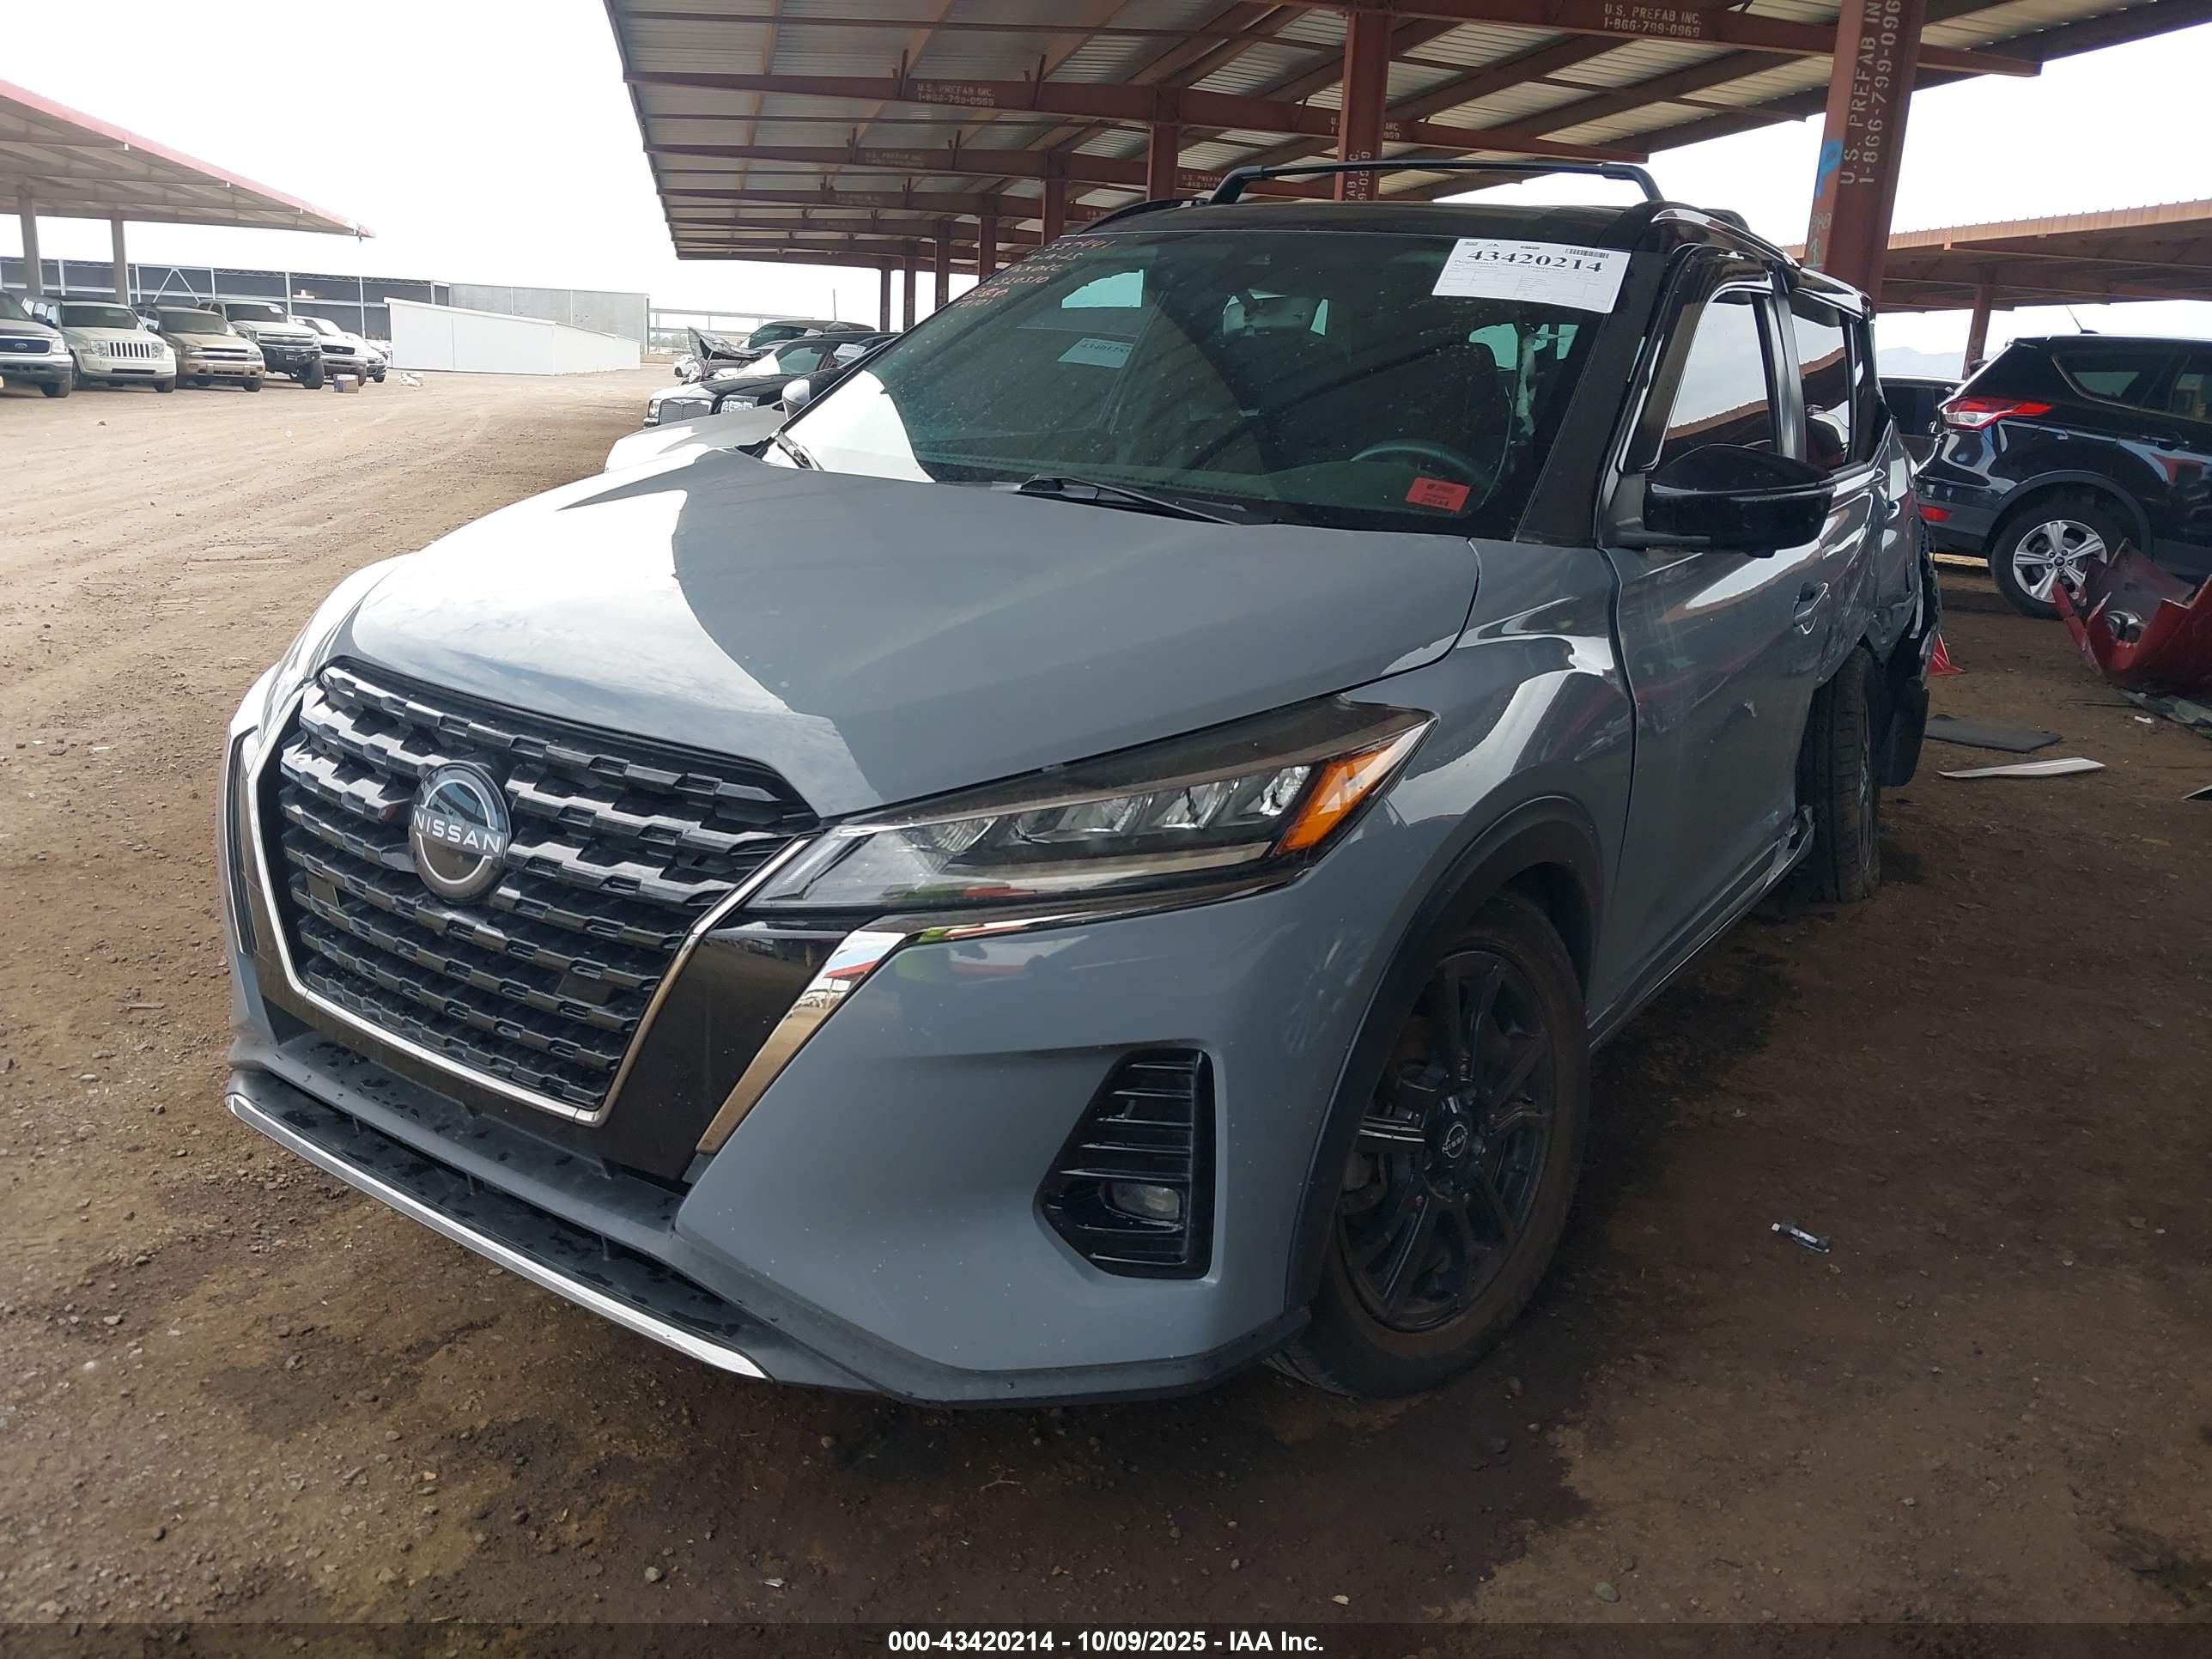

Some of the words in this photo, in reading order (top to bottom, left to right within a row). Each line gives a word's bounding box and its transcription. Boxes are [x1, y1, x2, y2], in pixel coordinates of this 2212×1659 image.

[1604, 3, 1626, 17] U.S.
[1632, 6, 1676, 21] PREFAB
[1681, 11, 1702, 25] INC.
[1604, 17, 1701, 37] 1-866-799-0969
[939, 84, 974, 95] PREFAB
[1848, 36, 1876, 127] PREFAB
[1839, 143, 1862, 185] U.S.
[1467, 251, 1602, 272] 43420214
[413, 810, 501, 854] NISSAN
